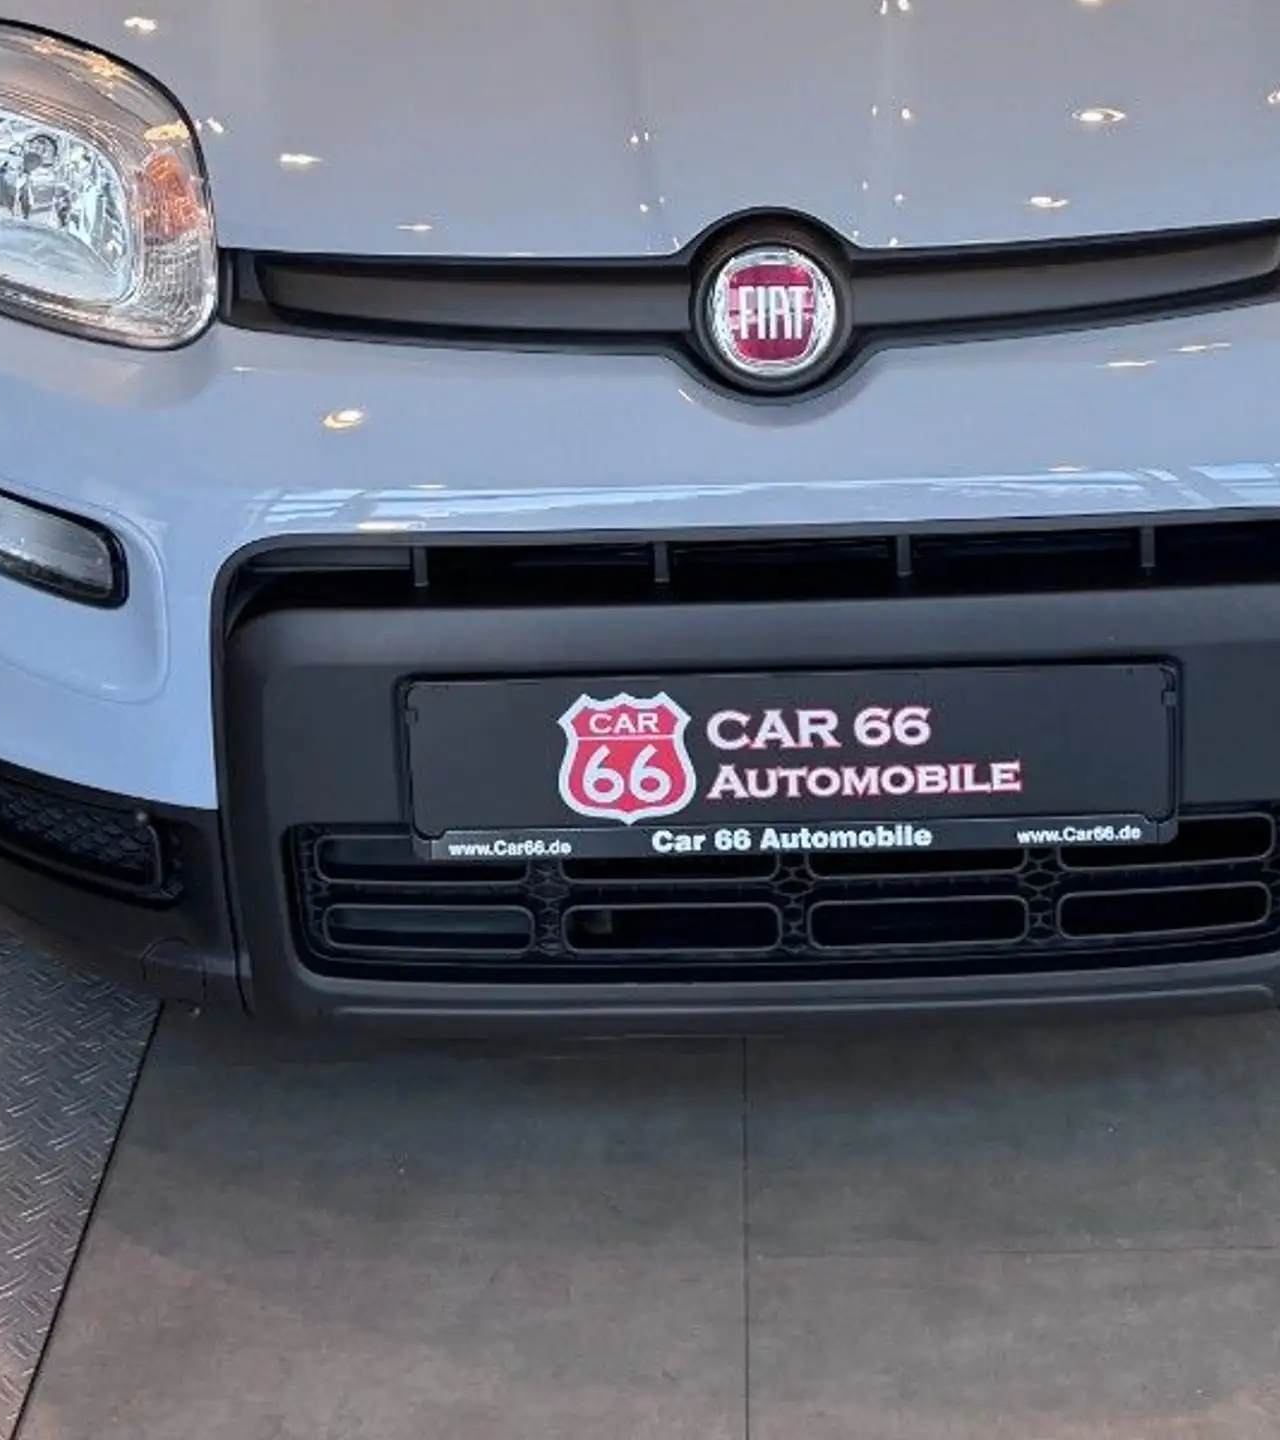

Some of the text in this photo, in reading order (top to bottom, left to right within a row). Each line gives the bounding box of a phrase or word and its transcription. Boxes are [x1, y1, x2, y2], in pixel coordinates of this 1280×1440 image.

[738, 284, 809, 341] FIAT
[588, 712, 661, 735] CAR
[706, 706, 932, 751] CAR 66
[581, 744, 673, 804] 66
[706, 760, 1022, 801] AUTOMOBILE
[448, 839, 572, 857] www.Car66.de
[651, 823, 933, 853] Car 66 Automobile
[1016, 825, 1141, 844] www.Car66.de
